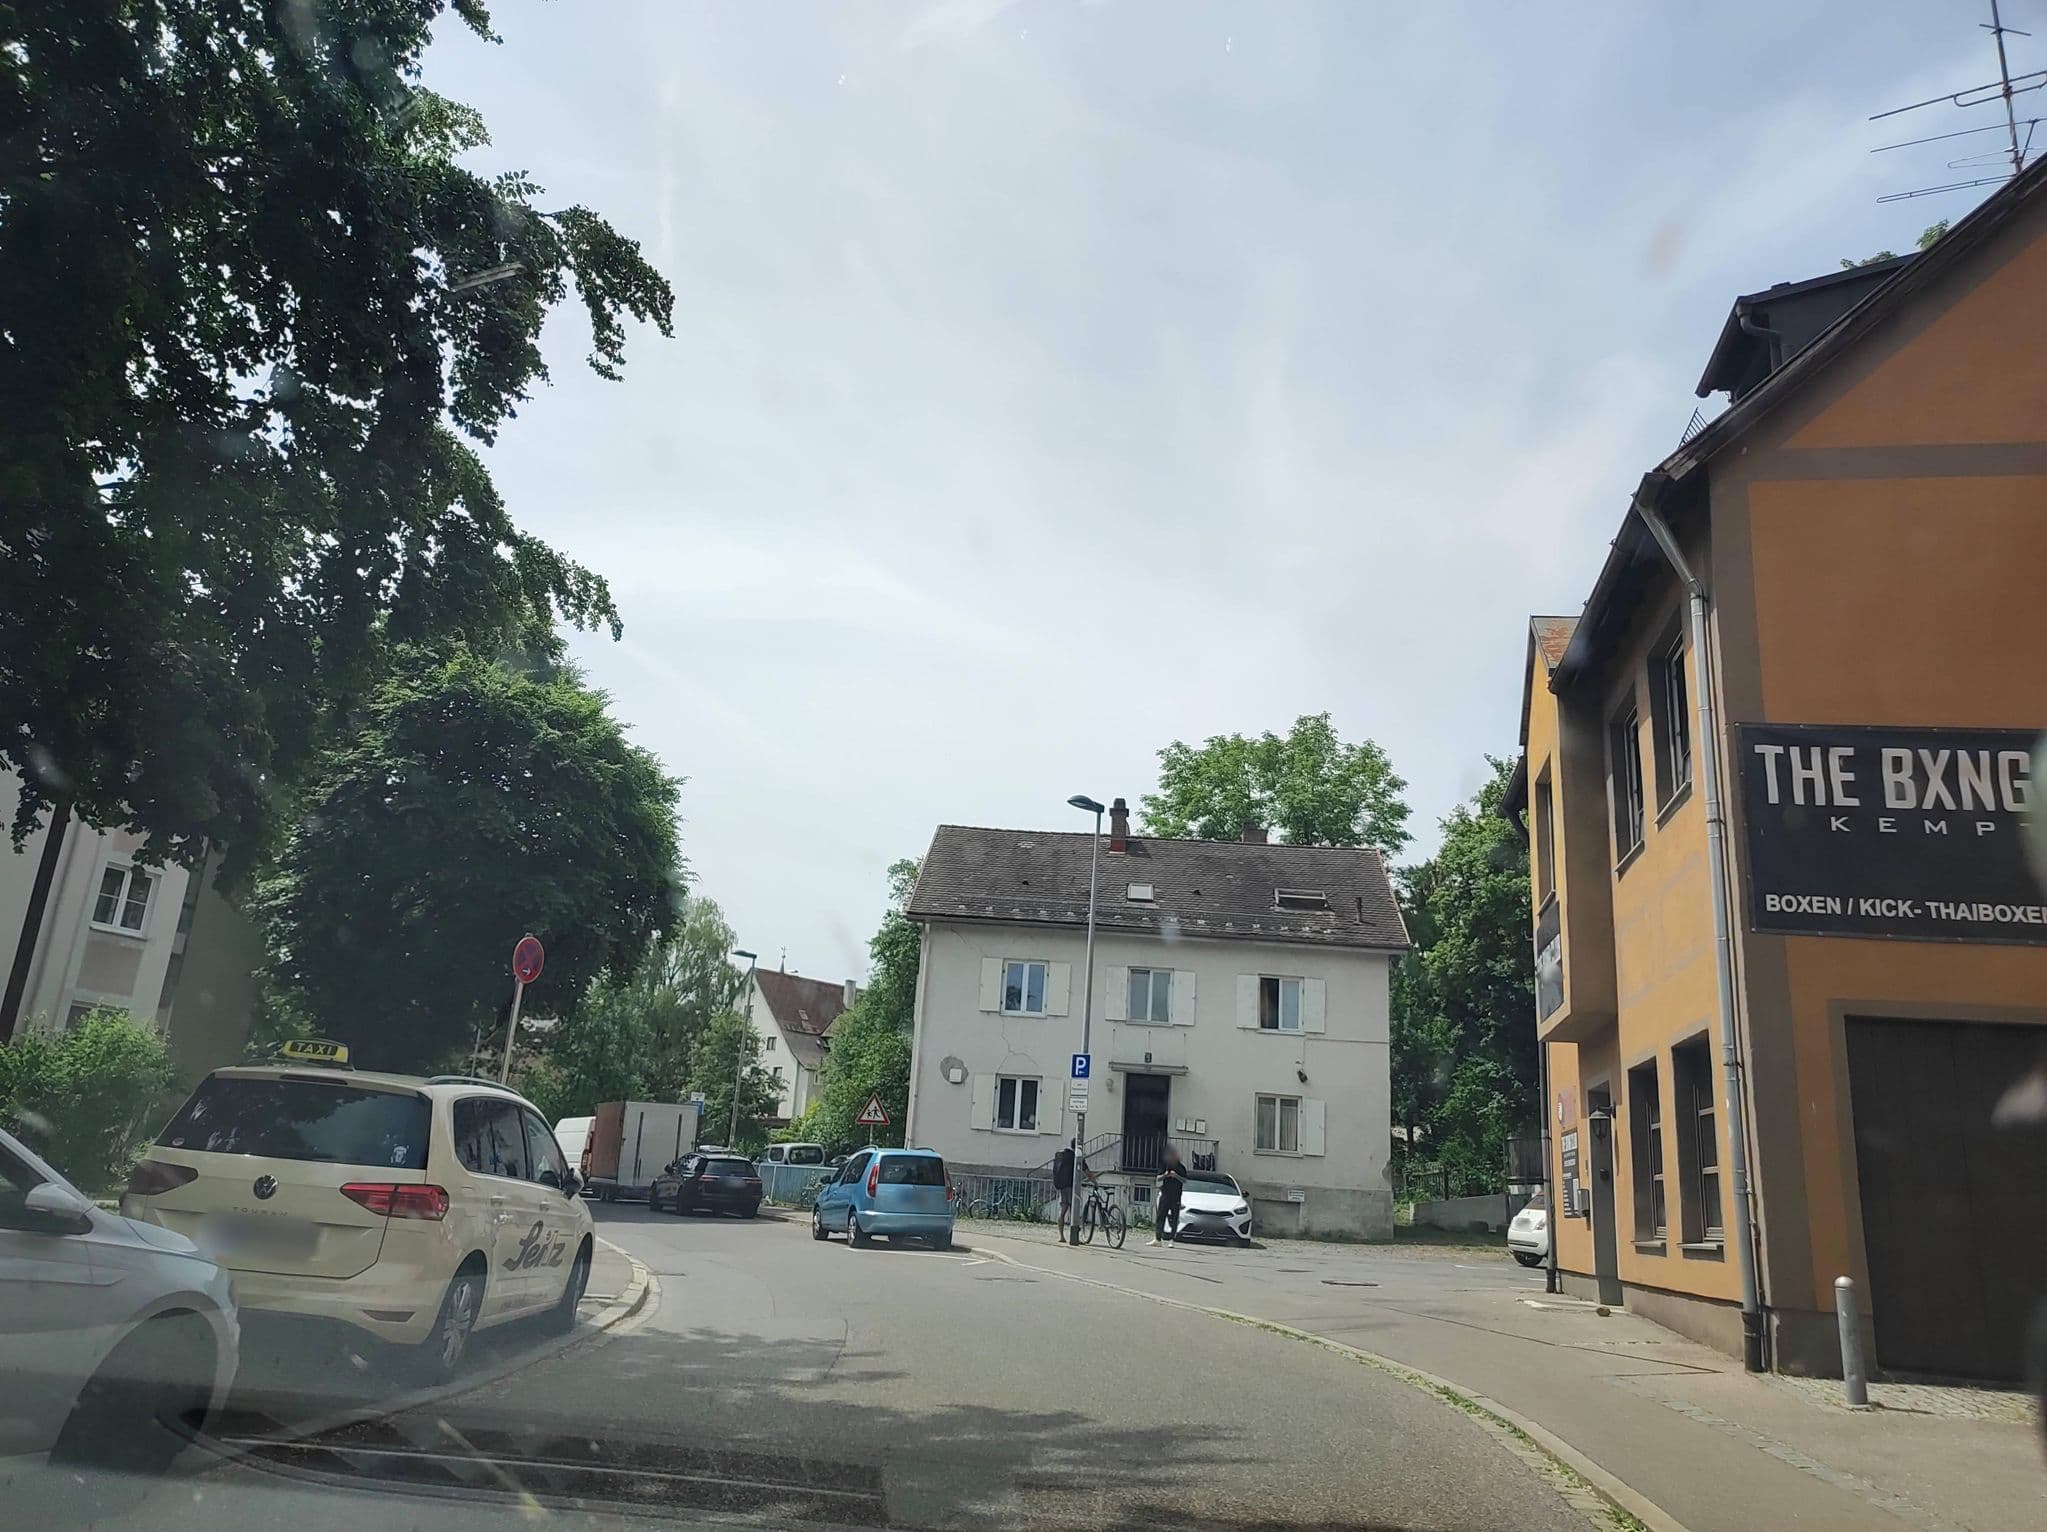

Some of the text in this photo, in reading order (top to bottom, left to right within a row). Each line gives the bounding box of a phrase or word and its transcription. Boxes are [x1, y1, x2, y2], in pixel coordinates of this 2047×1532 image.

[1754, 744, 2033, 813] THE BXNG
[1765, 894, 1841, 915] BOXEN
[1859, 899, 1922, 919] KICK-
[297, 1042, 333, 1055] TAXI
[1075, 1056, 1087, 1077] P
